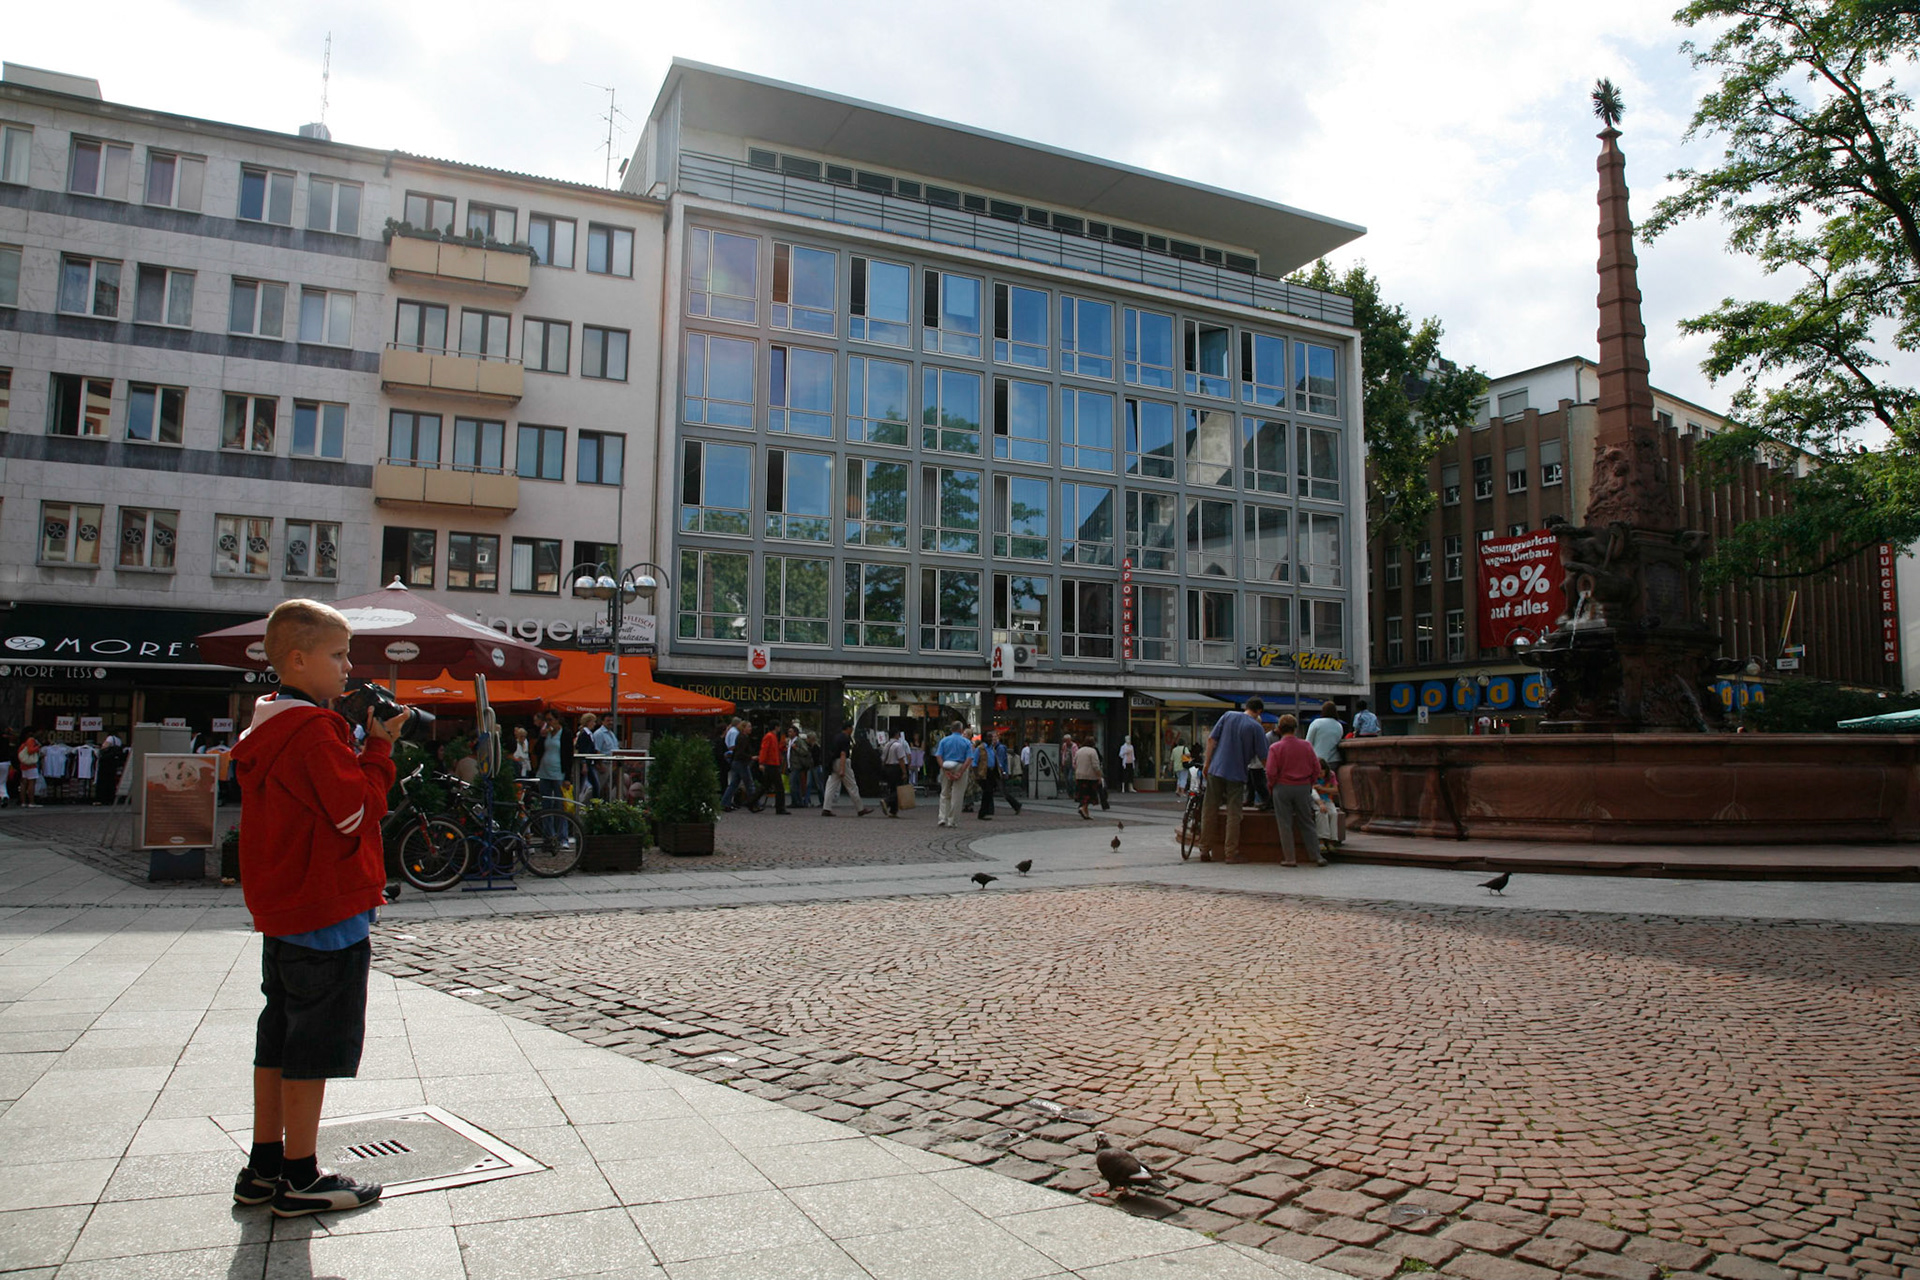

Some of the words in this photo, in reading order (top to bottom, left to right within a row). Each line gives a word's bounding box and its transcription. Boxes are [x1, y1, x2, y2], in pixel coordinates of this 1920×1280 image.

[1488, 563, 1550, 599] 20%
[1880, 546, 1892, 611] BURGER
[1123, 560, 1131, 658] APOTHEKE
[1490, 602, 1511, 619] auf
[1514, 599, 1549, 617] alles
[627, 615, 654, 629] FLEISCH
[54, 637, 183, 657] MORE
[1884, 619, 1895, 662] KING
[1292, 652, 1347, 671] Tchibo
[13, 665, 55, 678] MORE
[67, 666, 92, 679] LESS
[258, 672, 280, 684] MO
[37, 693, 89, 707] SCHLUSS
[1015, 699, 1043, 709] ADLER
[1044, 700, 1090, 710] APOTHEKE
[1393, 682, 1546, 708] Jorda
